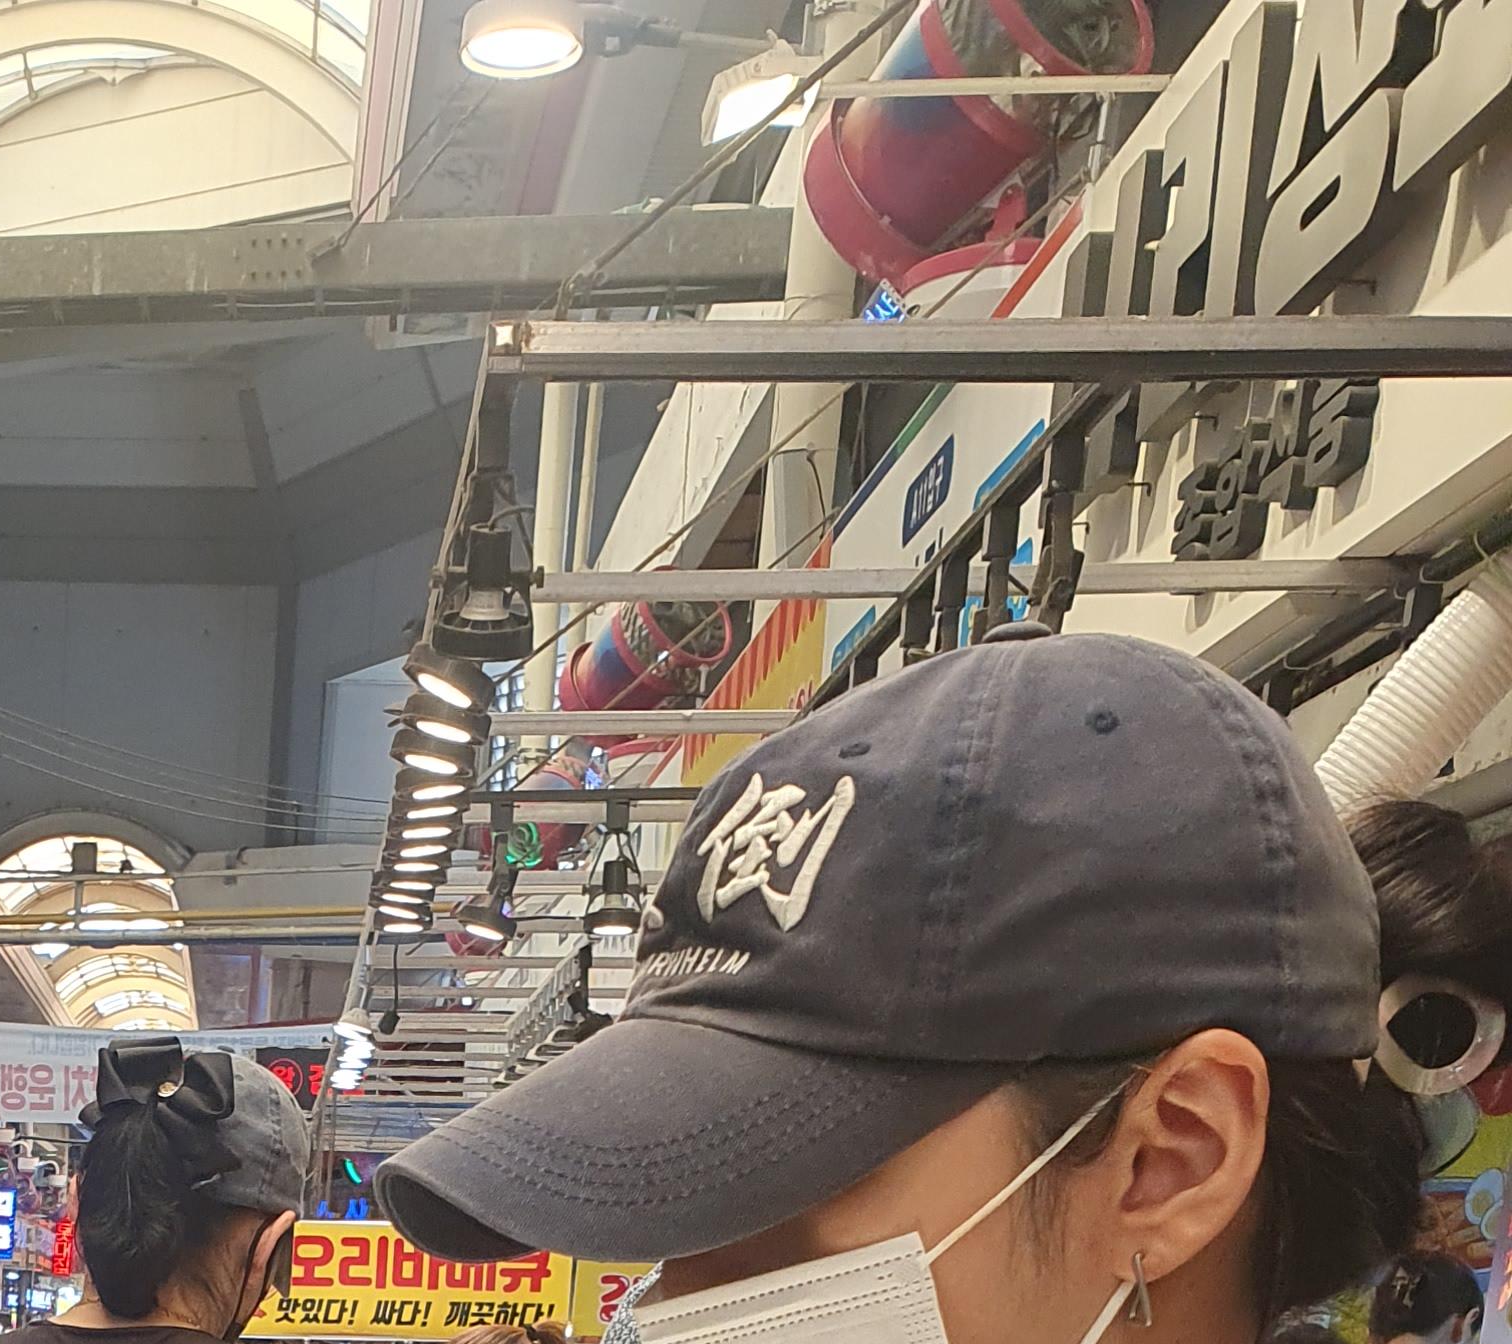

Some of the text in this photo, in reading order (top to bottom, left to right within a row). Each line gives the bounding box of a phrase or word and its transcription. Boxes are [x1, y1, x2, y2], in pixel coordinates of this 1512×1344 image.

[697, 772, 855, 932] 倒
[275, 1298, 356, 1326] 맛있다!
[370, 1301, 430, 1327] 싸다!
